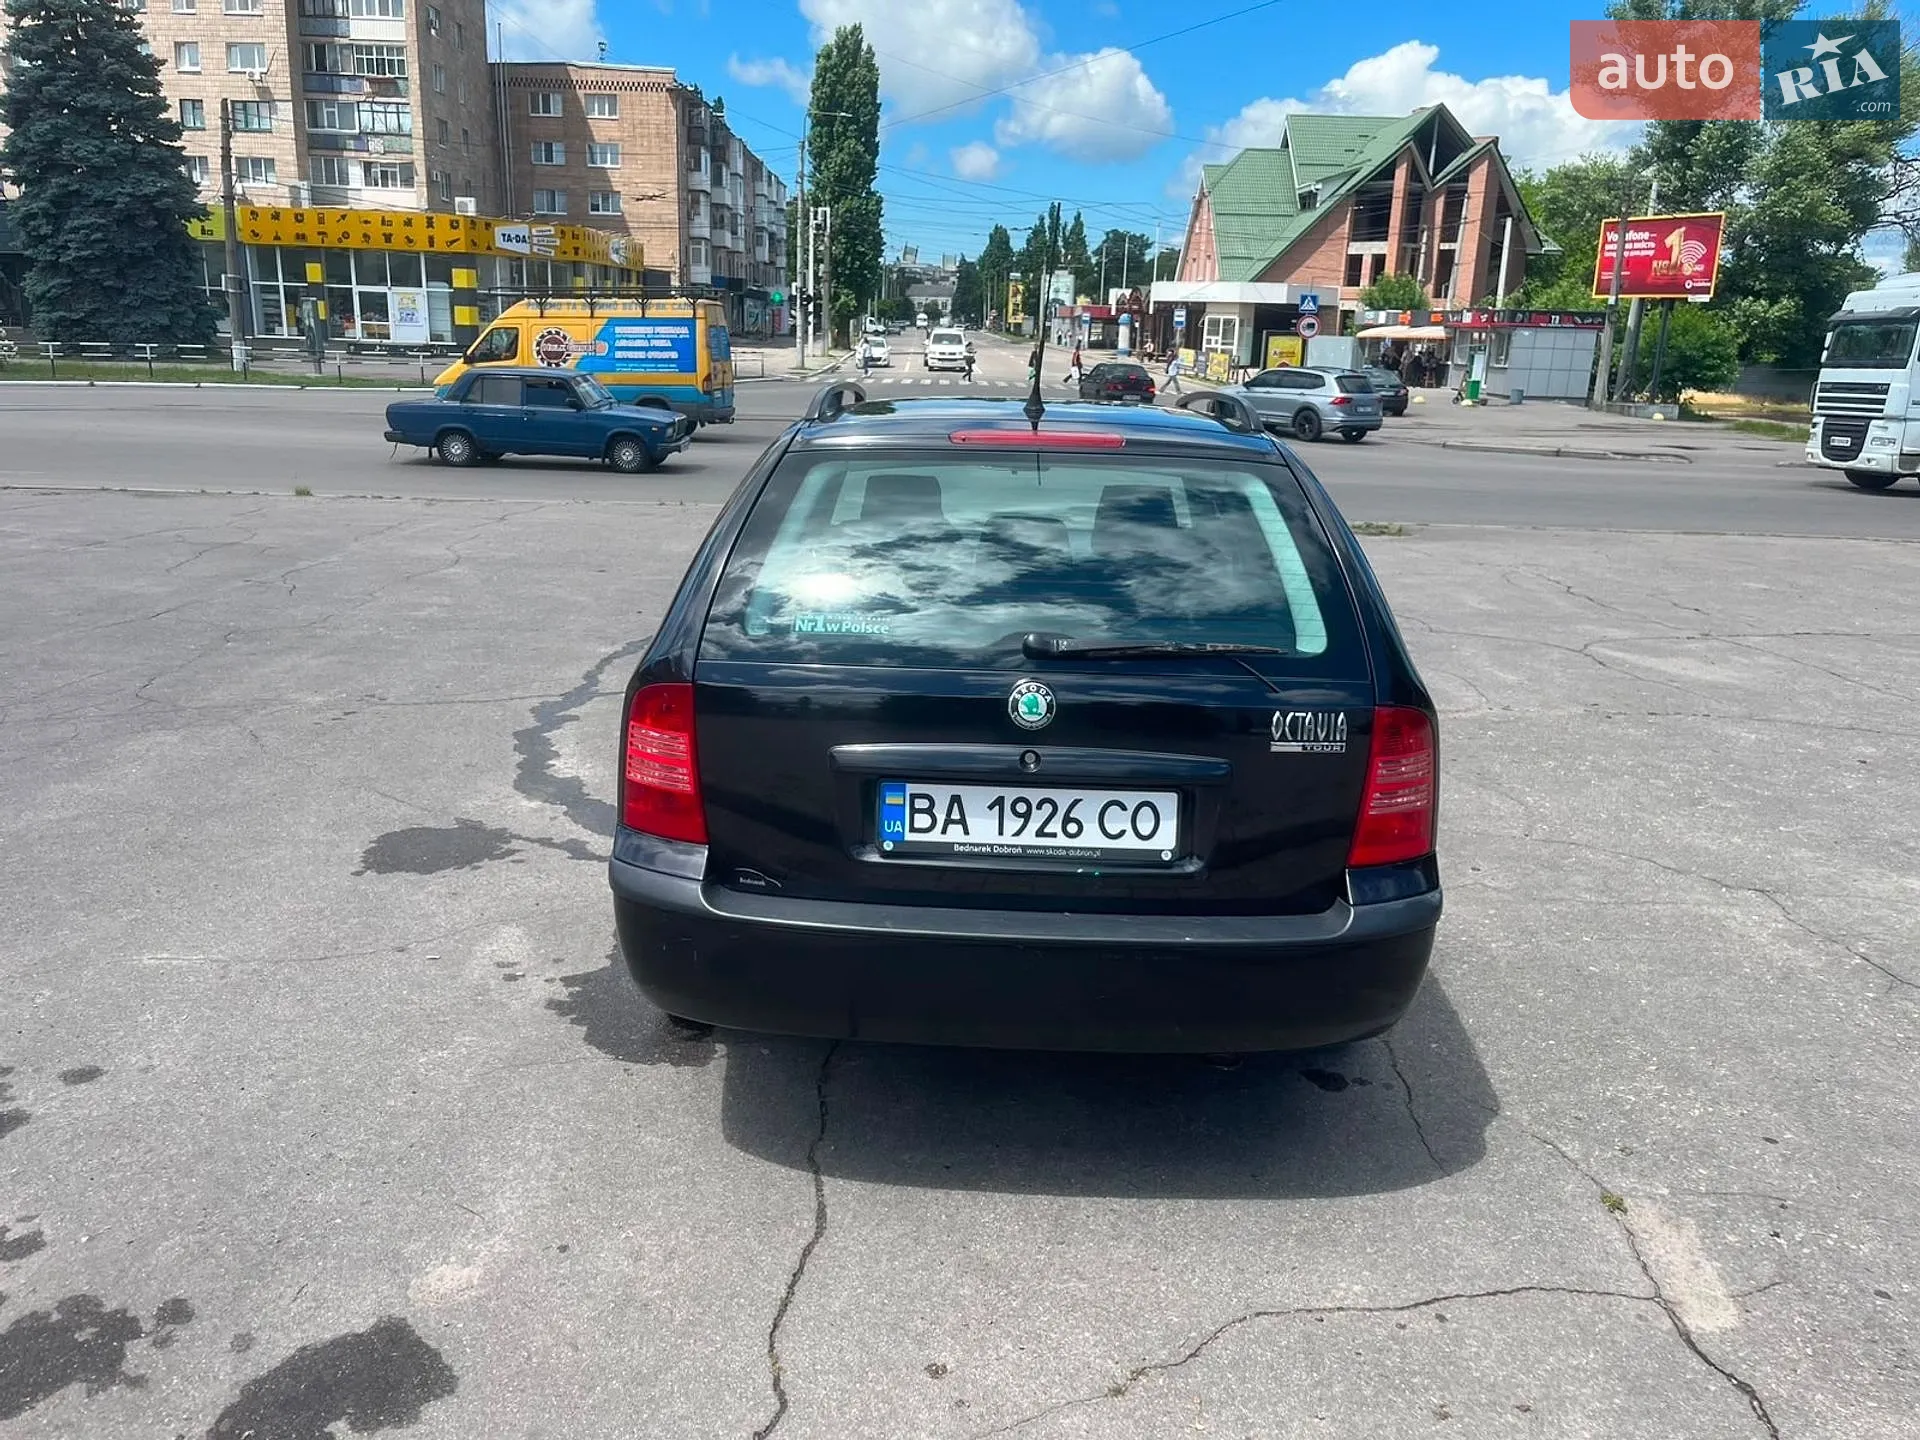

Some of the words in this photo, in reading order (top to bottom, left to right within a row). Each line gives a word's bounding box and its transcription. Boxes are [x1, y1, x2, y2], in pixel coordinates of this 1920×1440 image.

[1605, 230, 1650, 243] Vofone
[826, 622, 840, 632] w
[841, 620, 890, 634] Polsce
[1270, 710, 1348, 741] OCTAVIA
[1305, 744, 1341, 752] TOUR
[908, 792, 970, 836] BA
[986, 795, 1084, 839] 1926
[1097, 799, 1161, 841] CO
[884, 820, 904, 833] UA
[953, 843, 992, 854] Bednarek
[992, 844, 1023, 855] Dobroń
